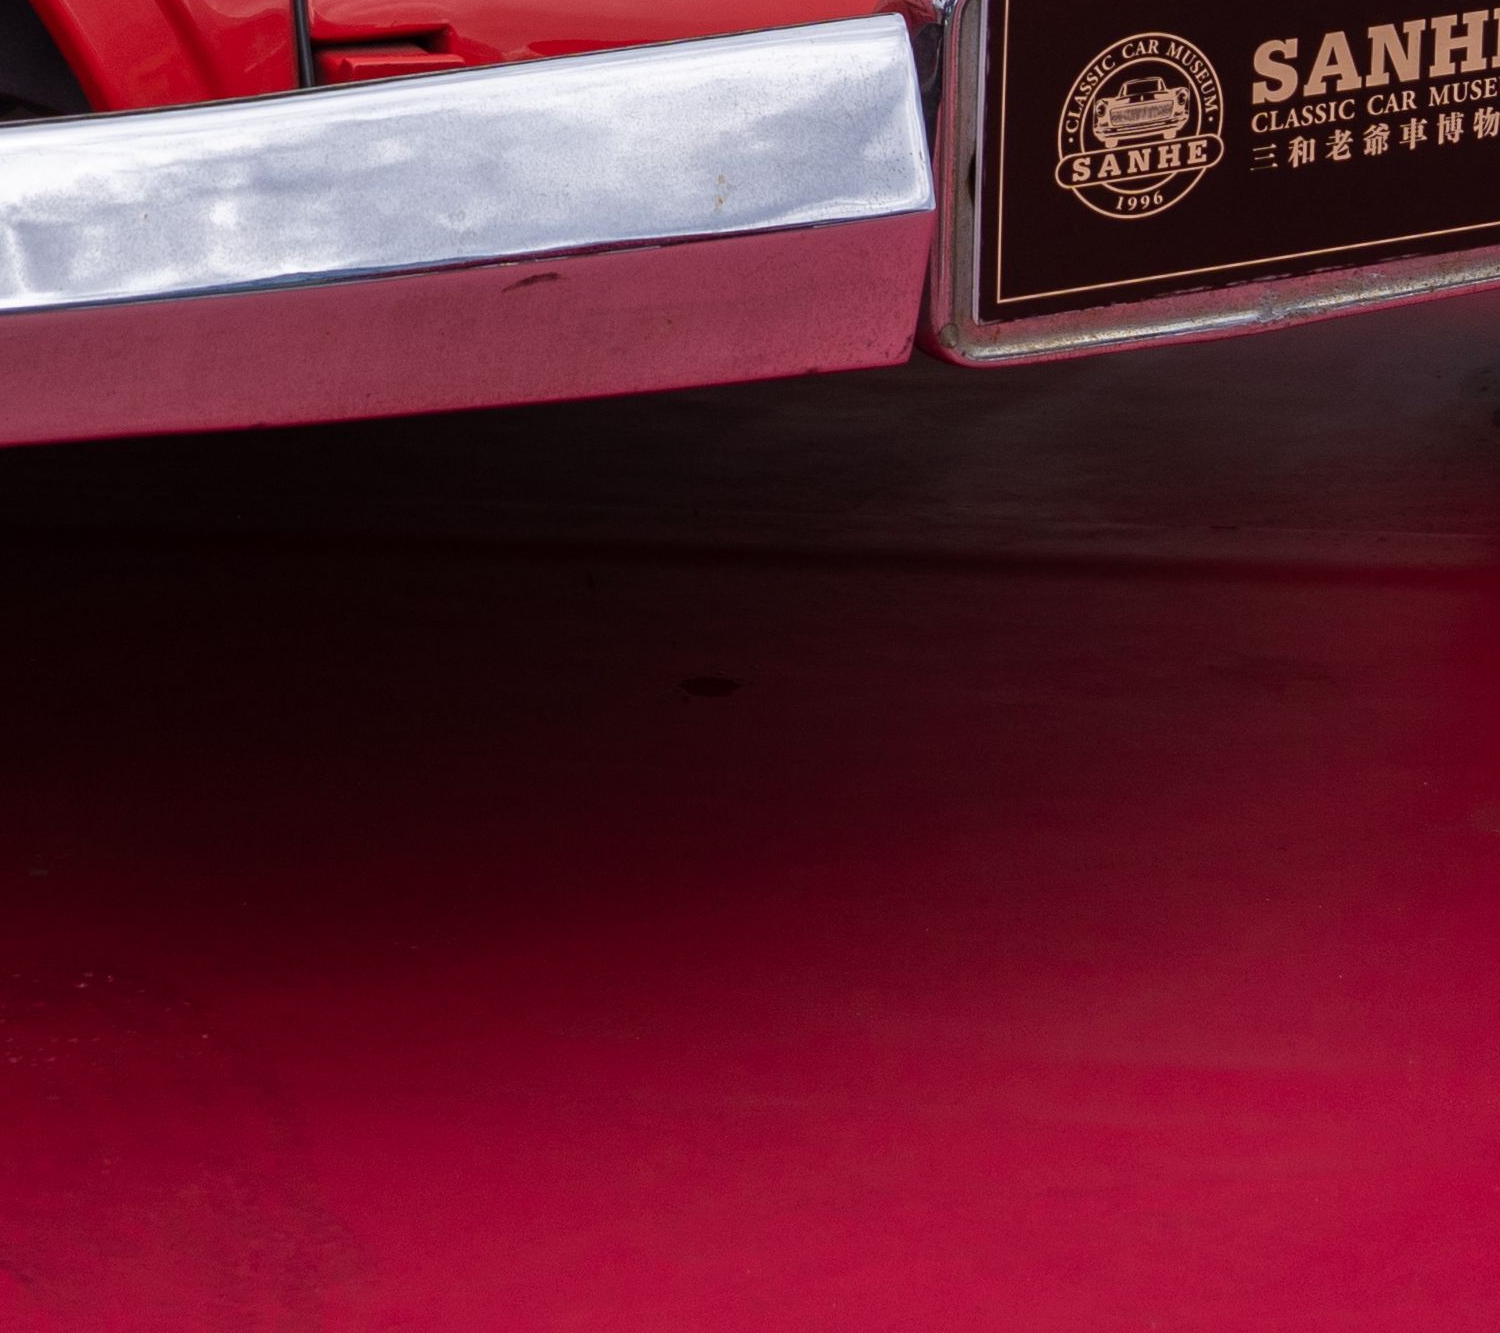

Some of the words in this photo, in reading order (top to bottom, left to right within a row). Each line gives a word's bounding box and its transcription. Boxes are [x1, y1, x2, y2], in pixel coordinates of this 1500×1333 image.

[1066, 54, 1117, 134] CLASSIC
[1122, 39, 1159, 59] CAR
[1166, 41, 1219, 113] MUSEUM
[1252, 98, 1356, 133] CLASSIC
[1366, 91, 1417, 115] CAR
[1072, 139, 1208, 182] SANHE
[1115, 190, 1164, 211] 1996
